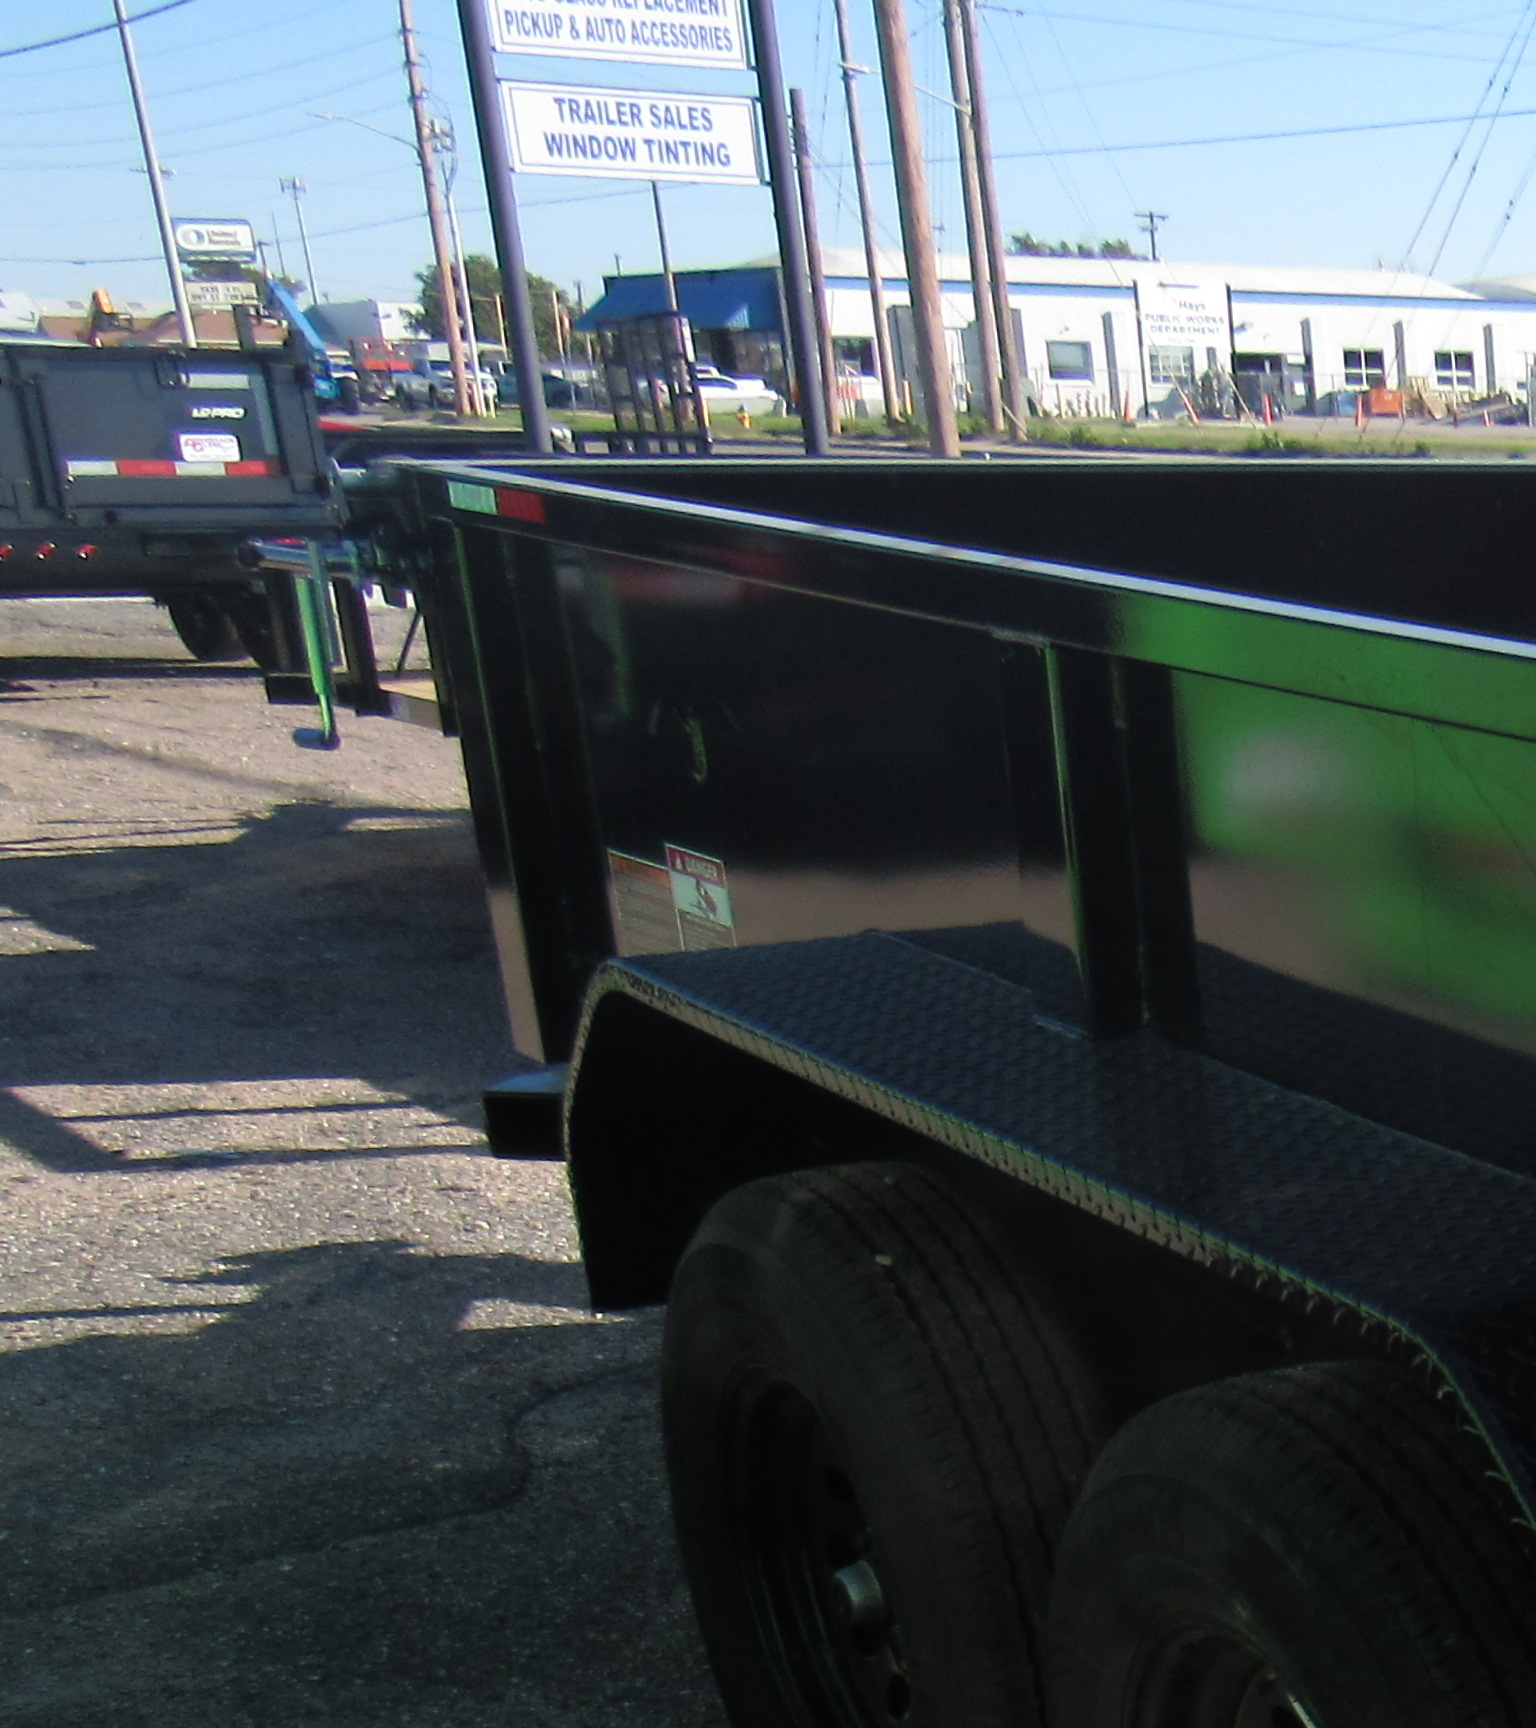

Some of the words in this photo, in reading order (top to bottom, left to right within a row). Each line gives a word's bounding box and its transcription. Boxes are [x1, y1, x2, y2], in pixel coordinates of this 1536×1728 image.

[504, 10, 563, 39] PICKUP
[570, 14, 581, 40] &
[586, 17, 626, 44] AUTO
[630, 19, 733, 52] ACCESSORIES
[553, 97, 644, 128] TRAILER
[650, 103, 713, 133] SALES
[543, 132, 636, 162] WINDOW
[642, 138, 731, 167] TINTING
[1145, 313, 1181, 323] PUBLIC
[1185, 315, 1224, 324] WORKS
[1150, 325, 1220, 335] DEPARTMENT
